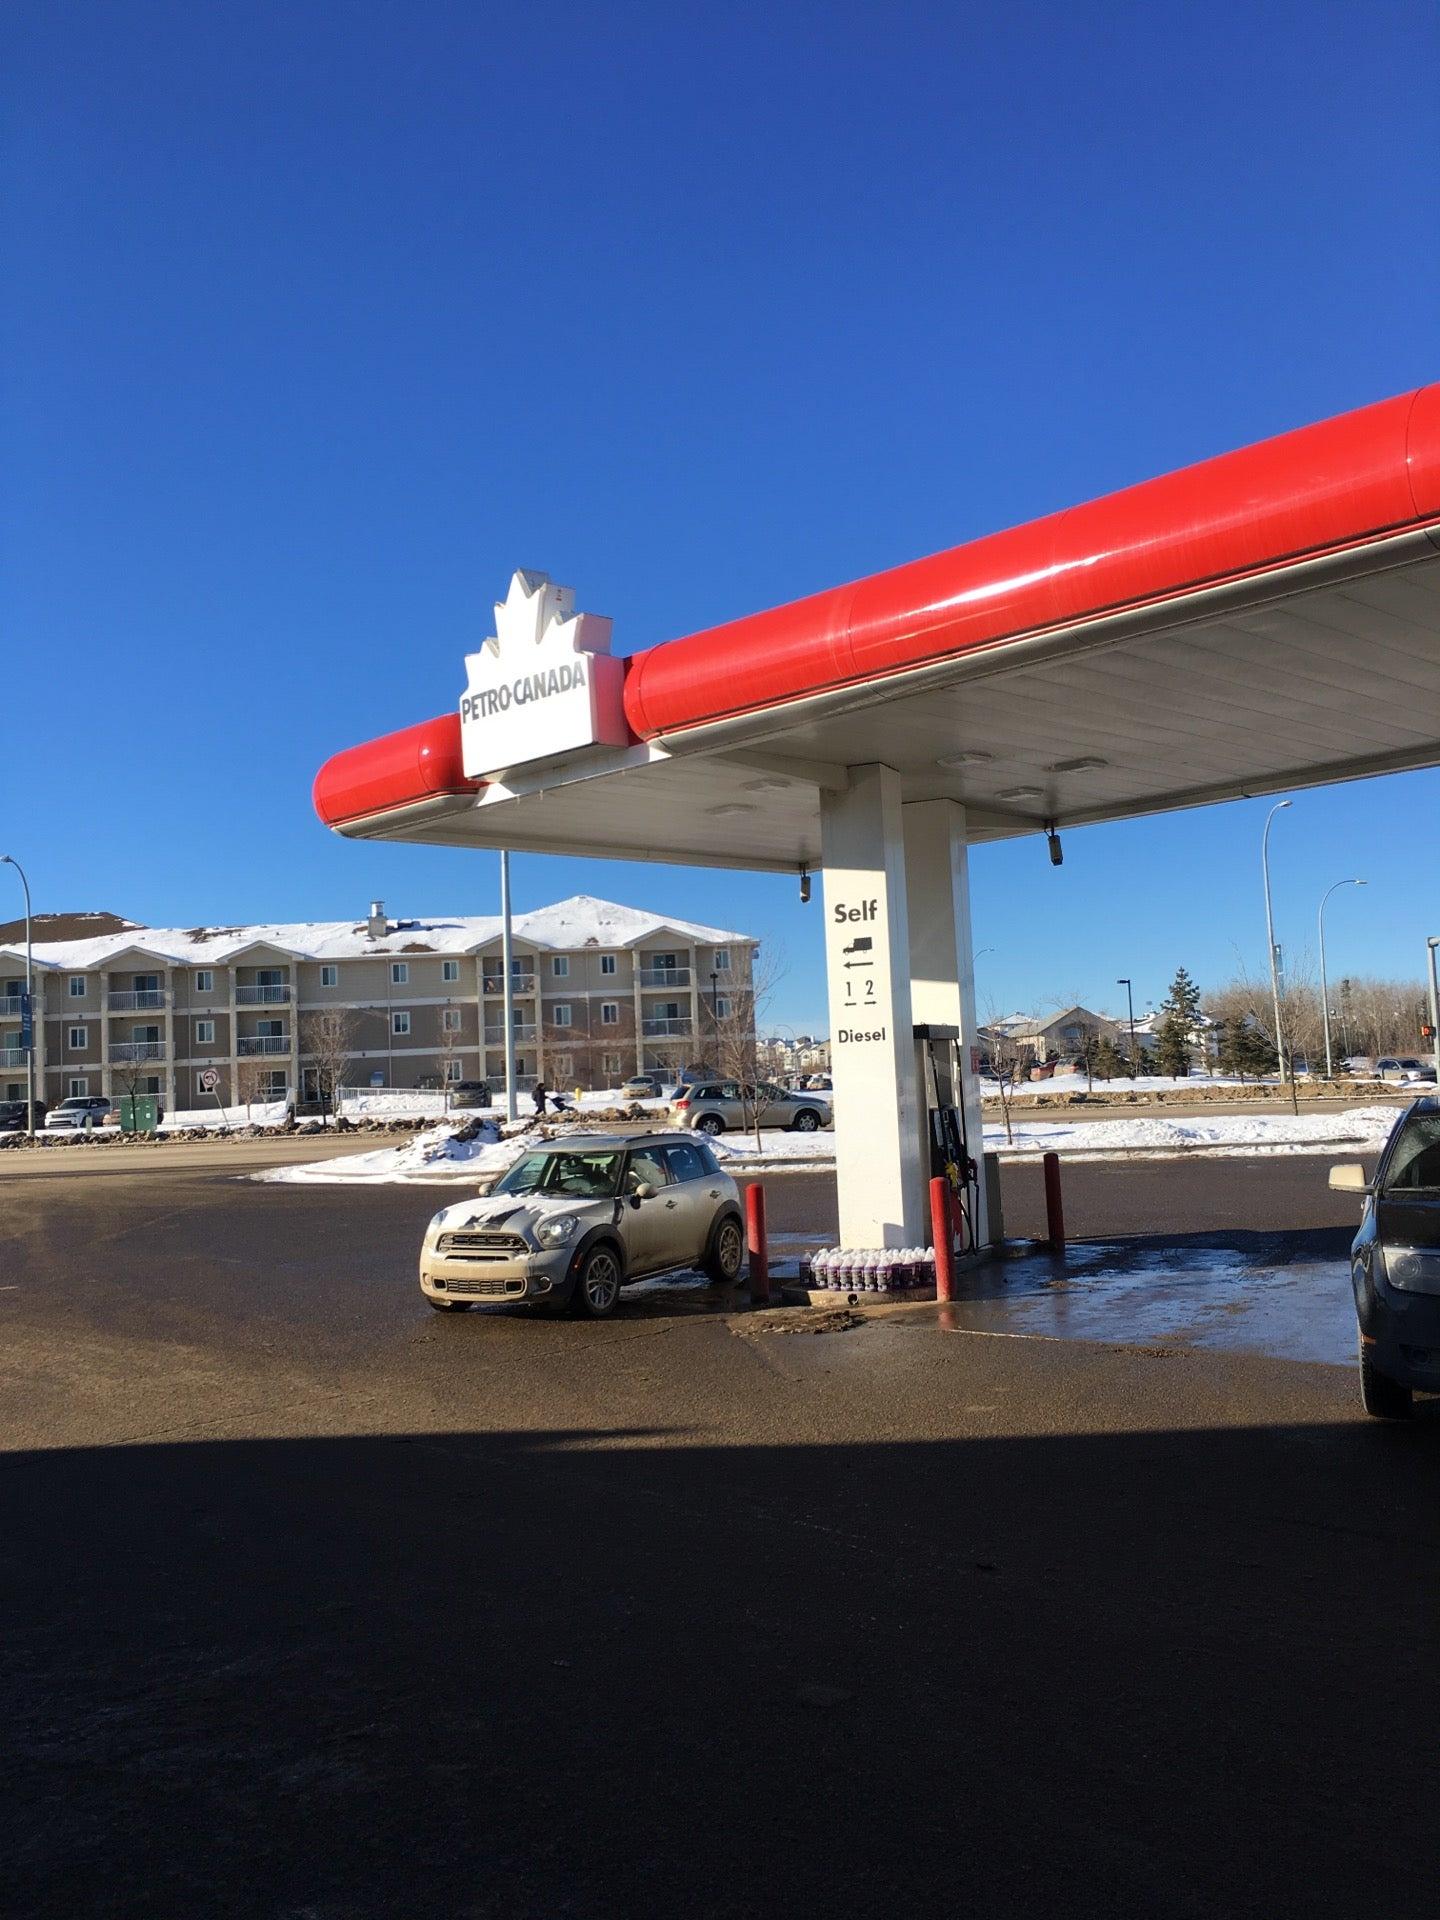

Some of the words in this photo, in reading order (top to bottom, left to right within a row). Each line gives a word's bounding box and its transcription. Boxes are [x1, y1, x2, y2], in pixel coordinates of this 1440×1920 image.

[834, 899, 878, 923] Self
[846, 981, 852, 997] 1
[865, 979, 874, 995] 2
[838, 1027, 886, 1043] Diesel
